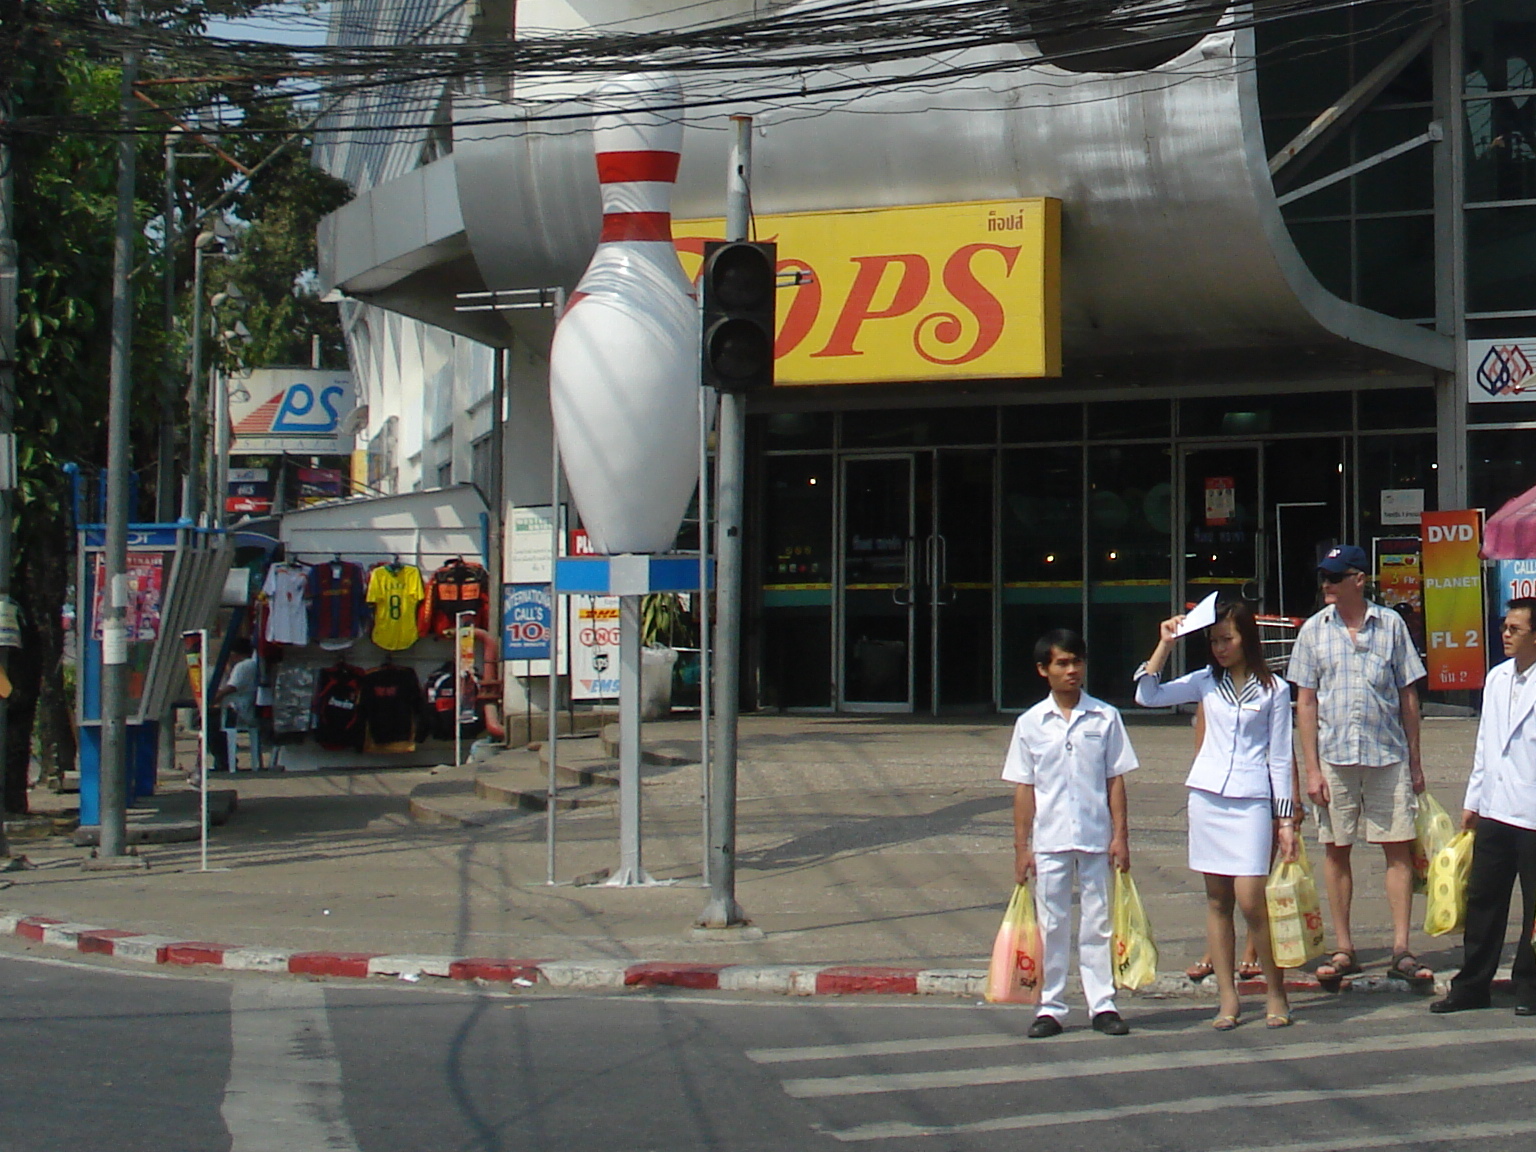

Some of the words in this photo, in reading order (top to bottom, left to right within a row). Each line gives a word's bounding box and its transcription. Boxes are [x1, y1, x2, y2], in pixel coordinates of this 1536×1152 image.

[676, 234, 1022, 365] OPS
[1427, 524, 1473, 543] DVD
[1426, 576, 1480, 589] PLANET
[389, 595, 401, 620] 8
[583, 630, 620, 644] TNT
[1431, 631, 1454, 649] FL
[1465, 630, 1479, 647] 2
